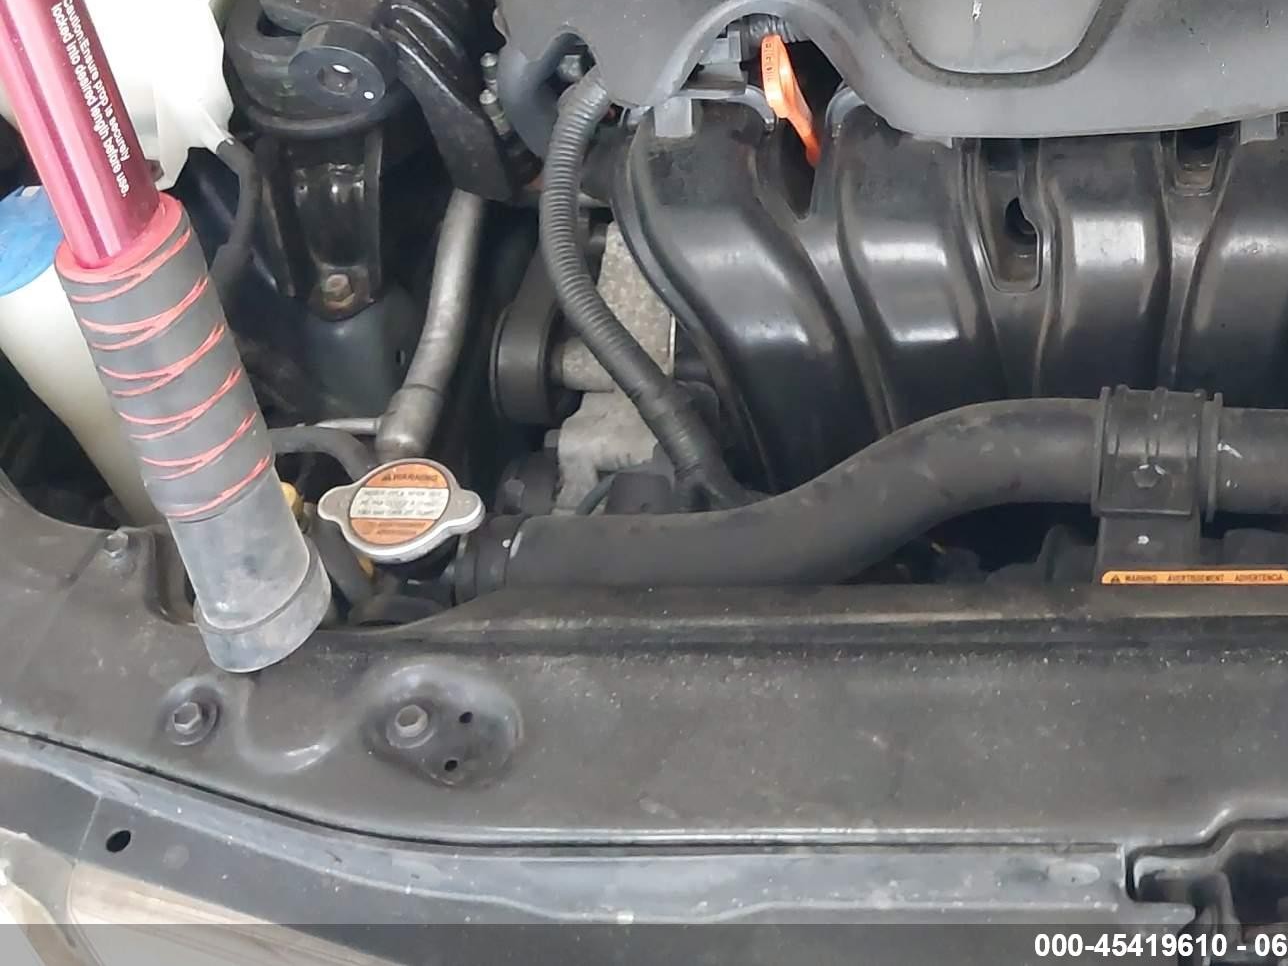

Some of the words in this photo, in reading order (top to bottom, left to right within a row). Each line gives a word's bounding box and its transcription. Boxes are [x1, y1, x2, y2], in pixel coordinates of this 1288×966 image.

[51, 2, 74, 44] locked
[66, 40, 80, 65] into
[75, 64, 98, 107] desired
[90, 101, 109, 140] length
[103, 136, 121, 174] before
[93, 79, 109, 107] prop
[104, 103, 113, 117] is
[109, 116, 130, 162] securely
